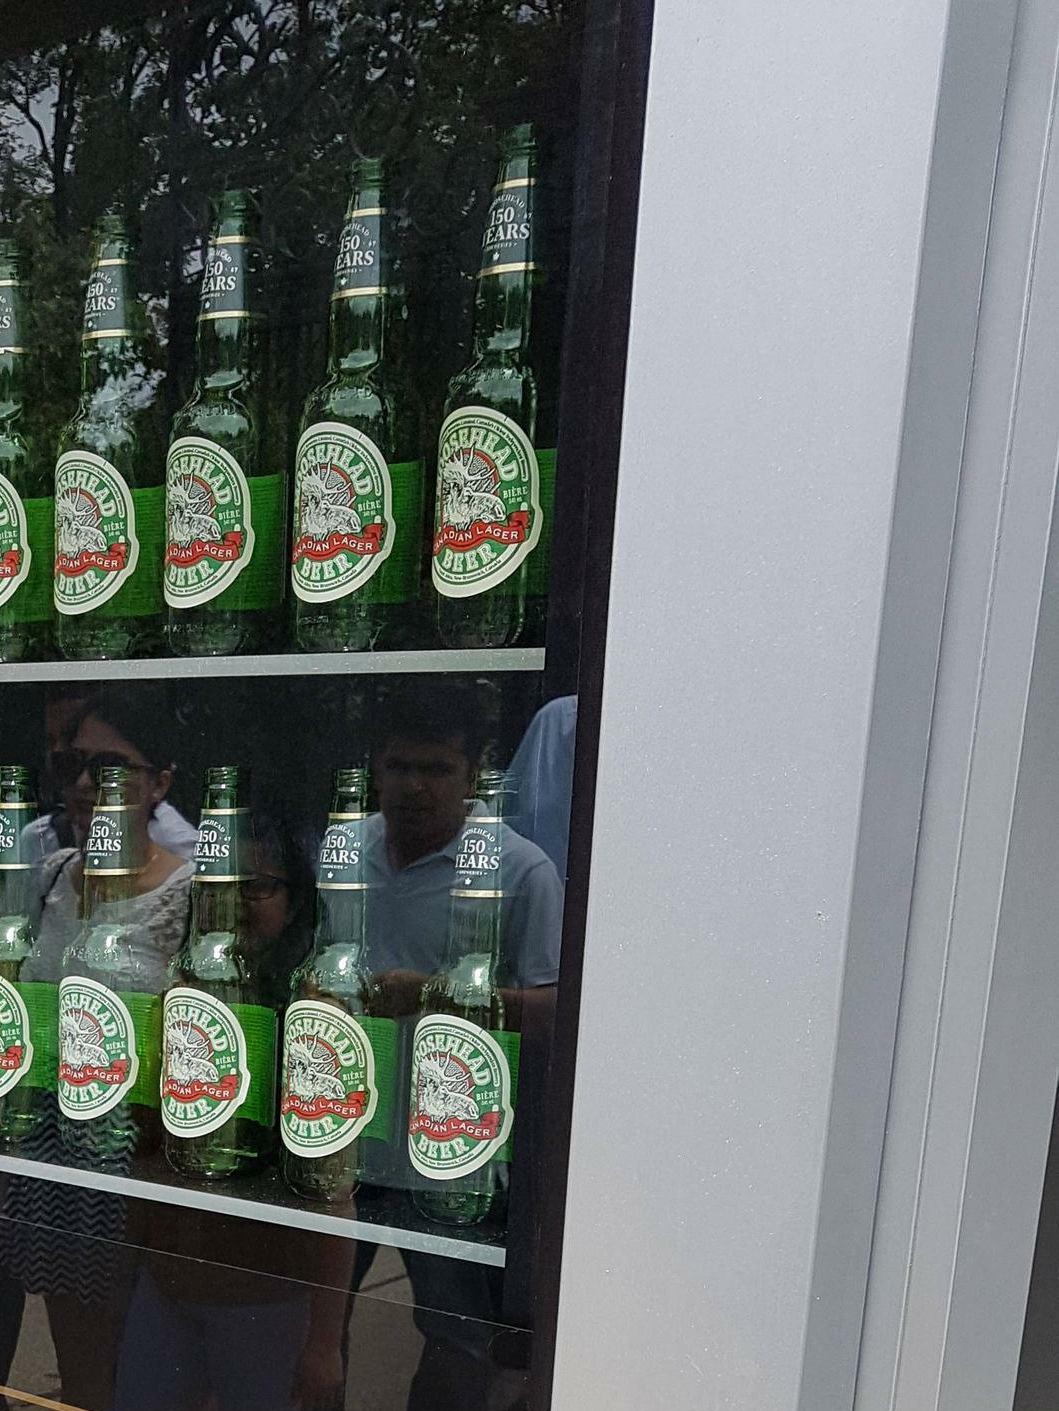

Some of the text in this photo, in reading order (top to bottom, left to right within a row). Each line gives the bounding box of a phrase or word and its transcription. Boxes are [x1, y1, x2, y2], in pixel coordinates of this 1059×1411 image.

[489, 206, 515, 227] 150
[341, 235, 359, 253] 150
[335, 250, 374, 271] EARS
[205, 261, 222, 276] 150
[201, 276, 236, 292] EARS
[85, 296, 116, 312] EARS
[503, 484, 527, 499] BIÈRE
[218, 509, 240, 520] BIÈRE
[358, 501, 381, 514] BIÈRE
[104, 522, 124, 533] BIÈRE
[476, 526, 518, 540] LAGER
[196, 544, 232, 558] LAGER
[333, 537, 373, 551] LAGER
[83, 556, 118, 568] LAGER
[443, 544, 497, 572] BEER
[170, 560, 214, 585] BEER
[301, 554, 351, 580] BEER
[58, 570, 100, 594] BEER
[92, 826, 109, 838] 150
[199, 830, 217, 843] 150
[326, 836, 346, 848] 150
[463, 840, 485, 853] 150
[106, 1042, 125, 1050] BIÈRE
[216, 1056, 236, 1066] BIÈRE
[86, 1068, 120, 1081] LAGER
[343, 1071, 364, 1080] BIÈRE
[63, 1081, 103, 1101] BEER
[194, 1085, 229, 1097] LAGER
[476, 1090, 499, 1100] BIÈRE
[168, 1097, 212, 1118] BEER
[319, 1101, 356, 1115] LAGER
[291, 1113, 338, 1137] BEER
[450, 1121, 490, 1136] LAGER
[416, 1134, 469, 1158] BEER
